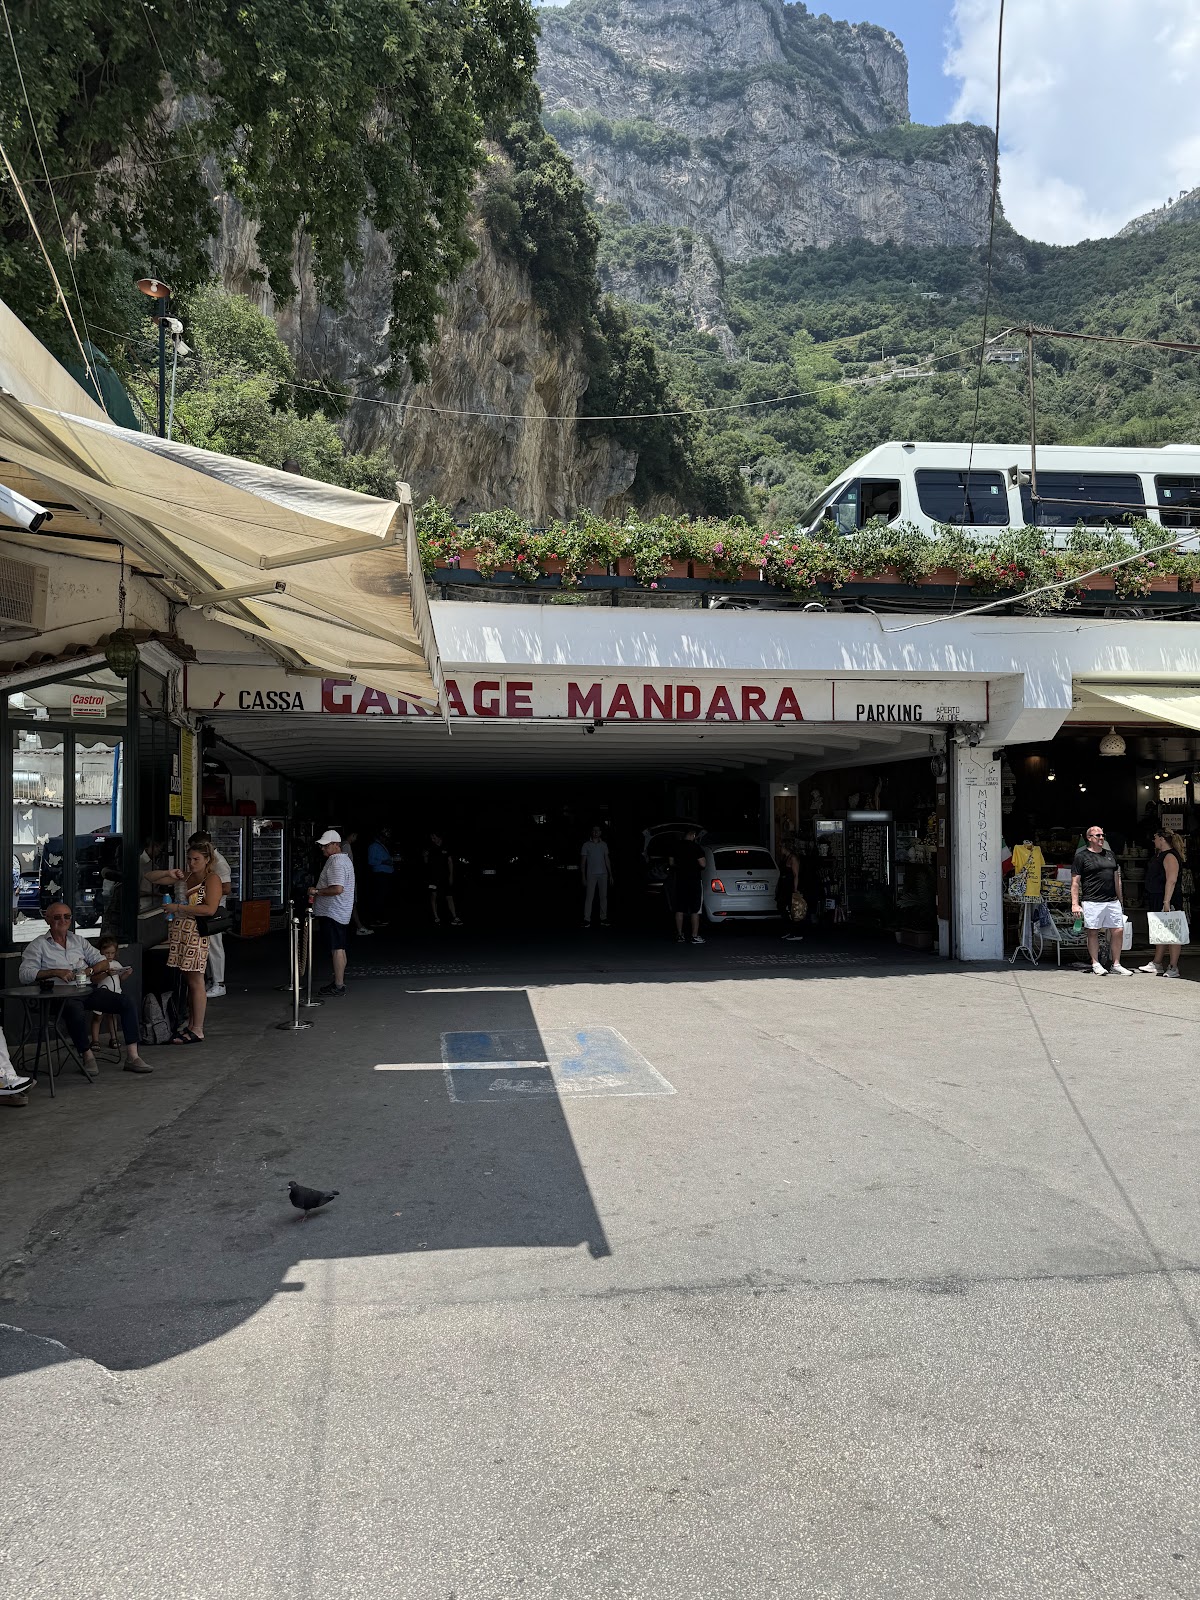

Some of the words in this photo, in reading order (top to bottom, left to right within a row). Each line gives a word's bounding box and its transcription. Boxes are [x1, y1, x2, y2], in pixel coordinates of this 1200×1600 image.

[72, 694, 105, 705] Castrol
[238, 690, 304, 711] CASSA
[568, 682, 804, 720] MANDARA
[856, 704, 922, 721] PARKING
[978, 870, 989, 922] STORE
